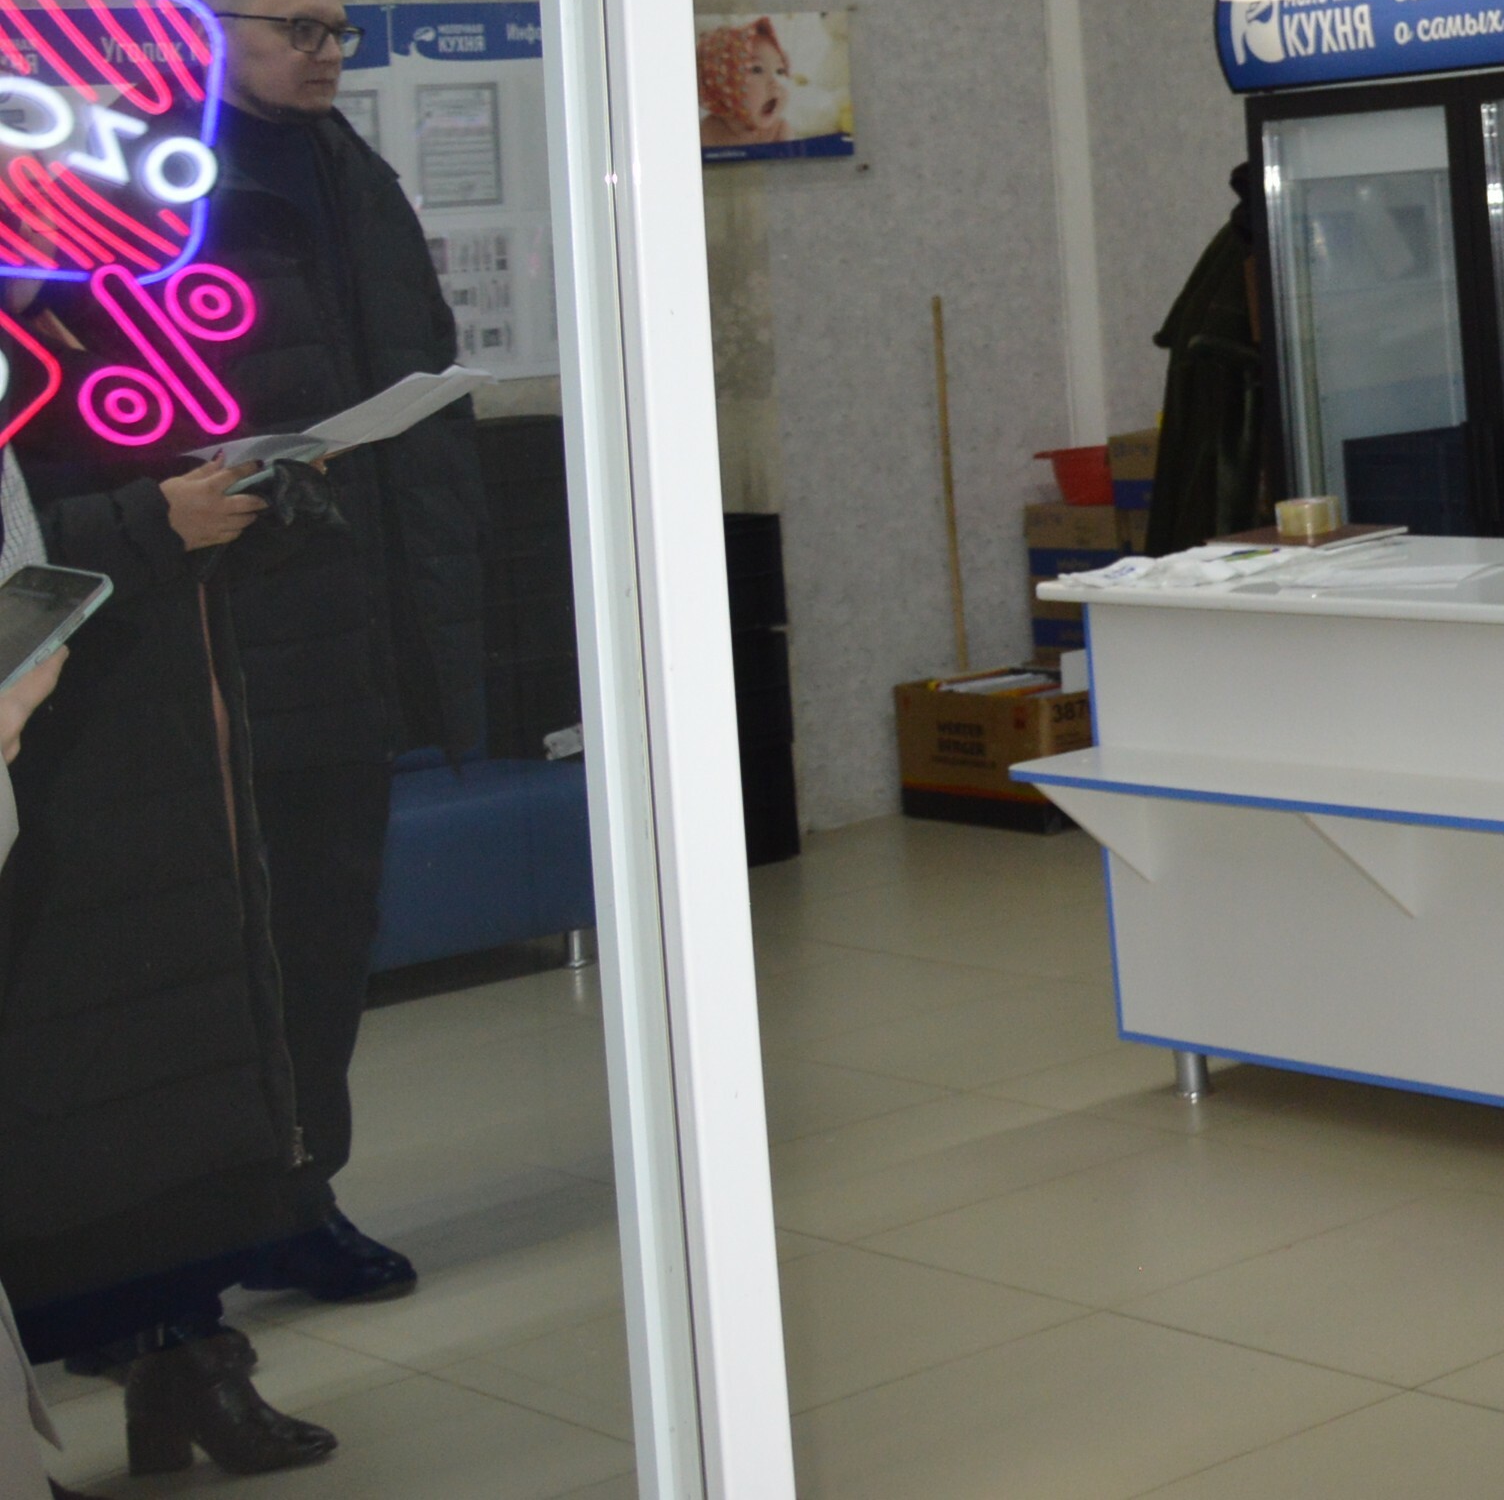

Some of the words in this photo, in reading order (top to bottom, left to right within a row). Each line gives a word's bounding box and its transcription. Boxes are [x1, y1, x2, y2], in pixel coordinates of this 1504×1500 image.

[1284, 5, 1375, 58] КУХНЯ
[1394, 26, 1413, 45] о
[1418, 9, 1504, 42] самых
